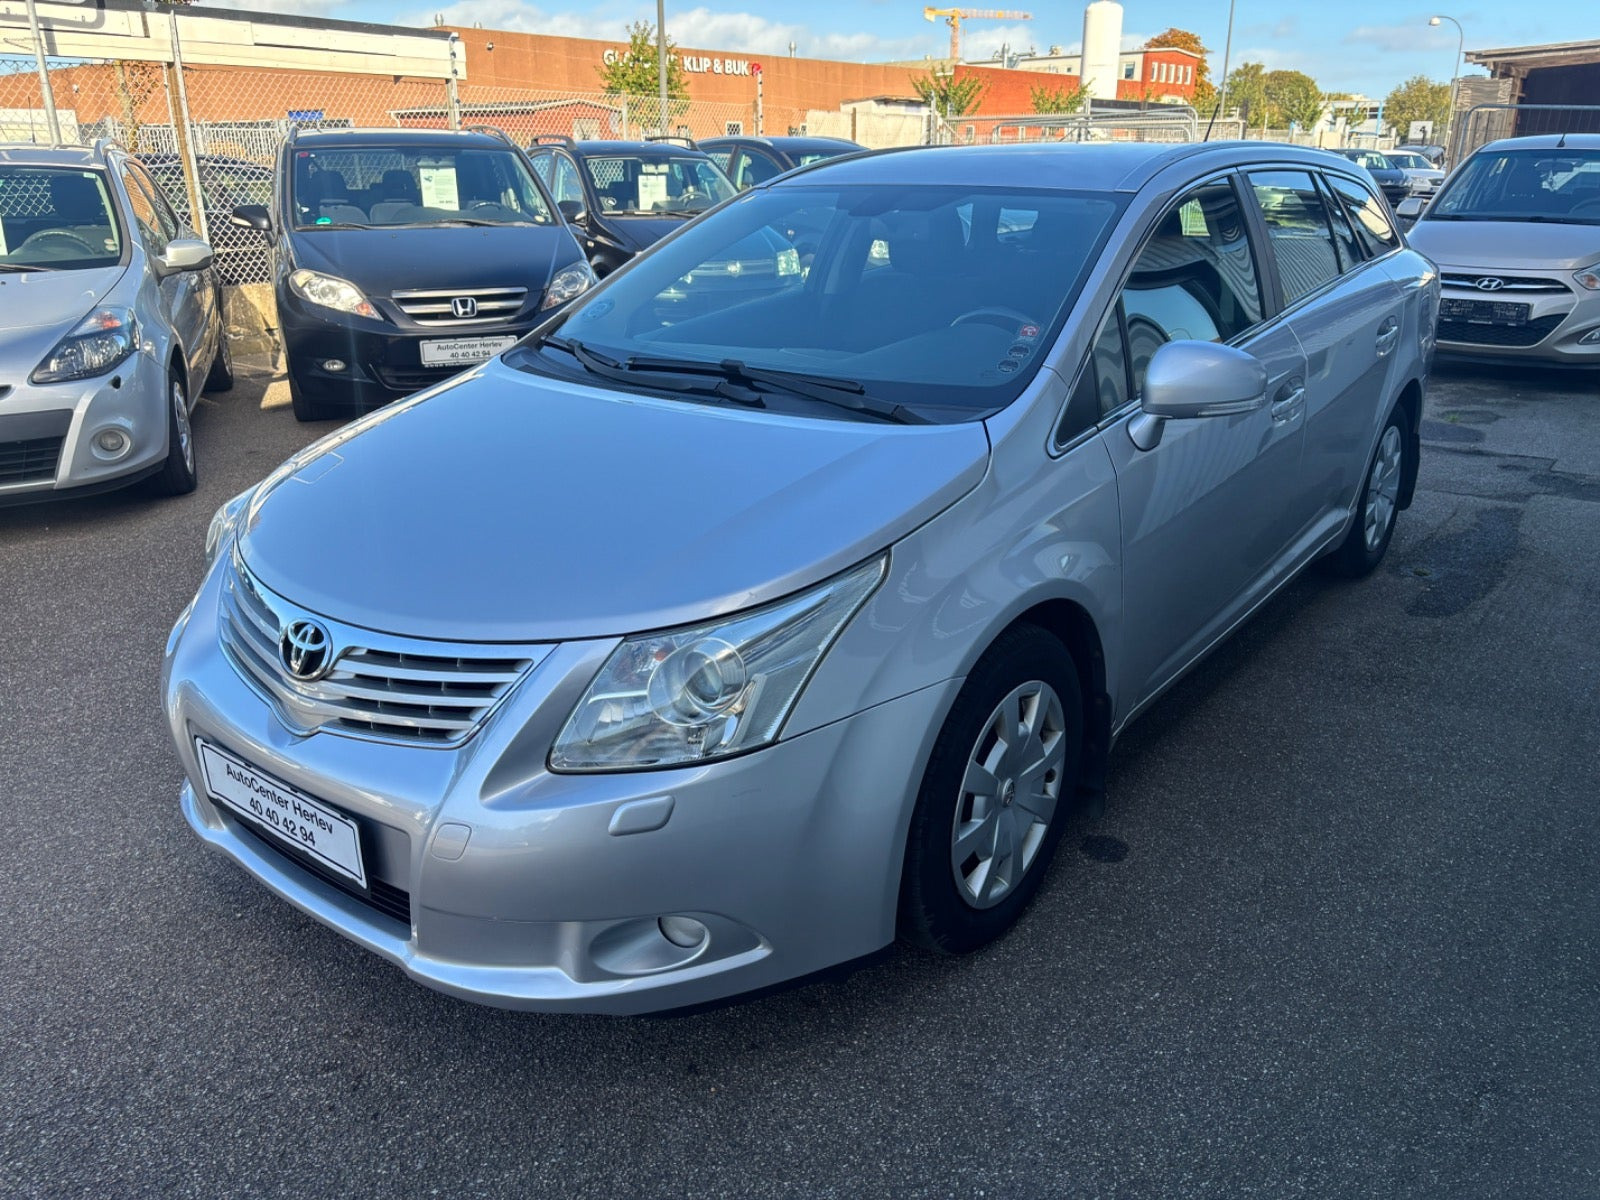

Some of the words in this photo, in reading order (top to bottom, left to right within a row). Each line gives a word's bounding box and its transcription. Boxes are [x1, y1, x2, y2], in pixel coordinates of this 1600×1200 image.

[683, 56, 711, 73] KLIP
[713, 58, 722, 74] &
[724, 59, 749, 76] BUK
[437, 343, 478, 351] AutoCenter
[226, 763, 289, 810] AutoCenter
[292, 803, 333, 834] Herlev
[249, 797, 262, 816] 40
[265, 807, 279, 826] 40
[282, 819, 297, 837] 42
[301, 827, 316, 846] 94
